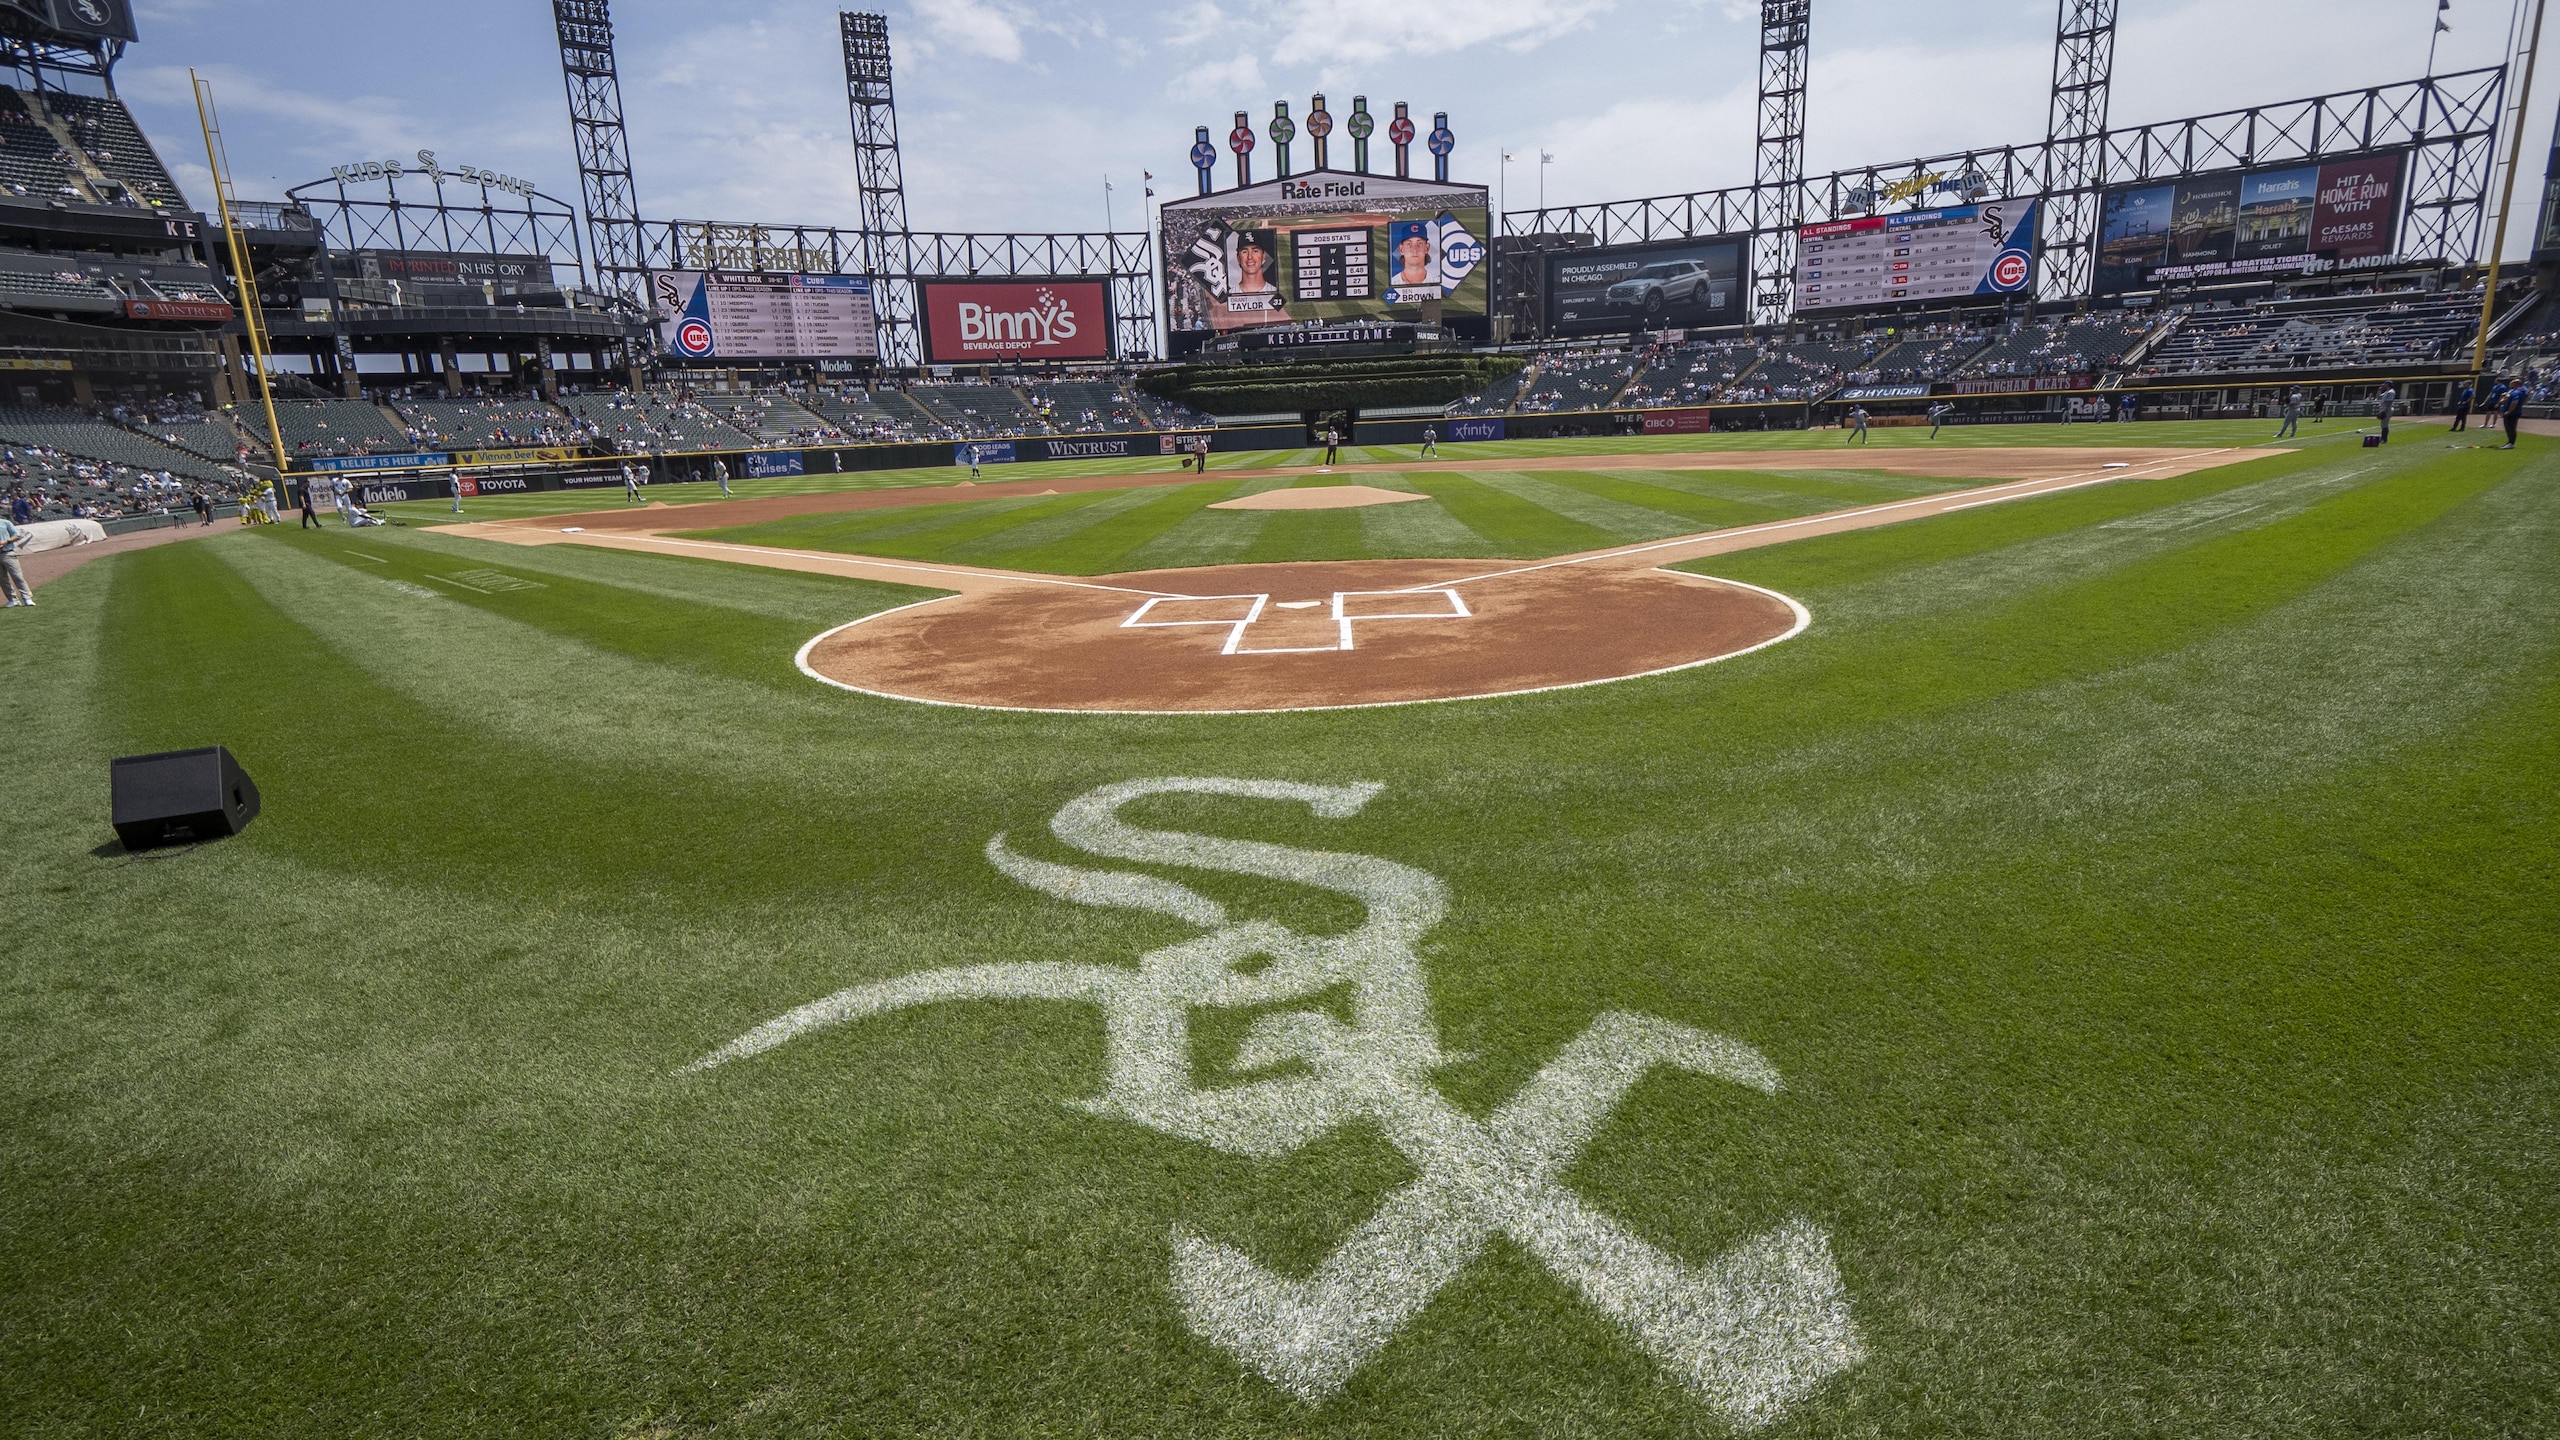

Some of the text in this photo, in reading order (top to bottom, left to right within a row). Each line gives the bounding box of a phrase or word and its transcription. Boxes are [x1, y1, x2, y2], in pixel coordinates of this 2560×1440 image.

[331, 160, 404, 185] KIDS
[459, 165, 535, 199] ZONE
[2336, 173, 2375, 187] HIT A
[1281, 181, 1365, 200] Rate Field
[1882, 170, 1946, 204] Miller
[2320, 182, 2389, 205] HOME RUN
[2333, 200, 2371, 213] WITH
[1903, 212, 1942, 223] STANDINGS
[686, 224, 771, 243] CAESARS
[1816, 224, 1852, 234] STANDINGS
[2321, 222, 2374, 235] CAESARS
[688, 244, 832, 272] SPORTSBOOK
[2182, 249, 2218, 258] HAMMOND
[388, 259, 526, 276] IMRINTED IN HISORY
[2155, 253, 2317, 275] OFFICIAL COMMEORATIVE TICKETS
[2338, 253, 2409, 270] LANDING
[1562, 262, 1638, 275] PROUDLY ASSEMBLED
[157, 303, 225, 316] WINTRUST
[1231, 302, 1264, 310] TAYLOR
[1268, 333, 1305, 345] KEYS
[1353, 329, 1392, 340] GAME
[1417, 332, 1440, 340] FAN DECK
[963, 341, 1032, 350] BEVERAGE DEPOT
[1227, 342, 1239, 350] DECK
[820, 359, 853, 372] Modelo
[1865, 387, 1923, 397] HYUNDAI
[1956, 379, 2029, 395] WHITTINGHAM
[2034, 377, 2071, 391] MEATS
[1614, 414, 1634, 423] THE
[1645, 419, 1666, 428] CIBC
[1455, 423, 1496, 439] xfinity
[1047, 440, 1128, 453] WINTRUST
[477, 449, 535, 462] Vienna Beef
[340, 456, 420, 469] RELIEF IS HERE
[750, 464, 788, 474] cuises
[480, 479, 527, 491] TOYOTA
[563, 477, 582, 485] YOUR
